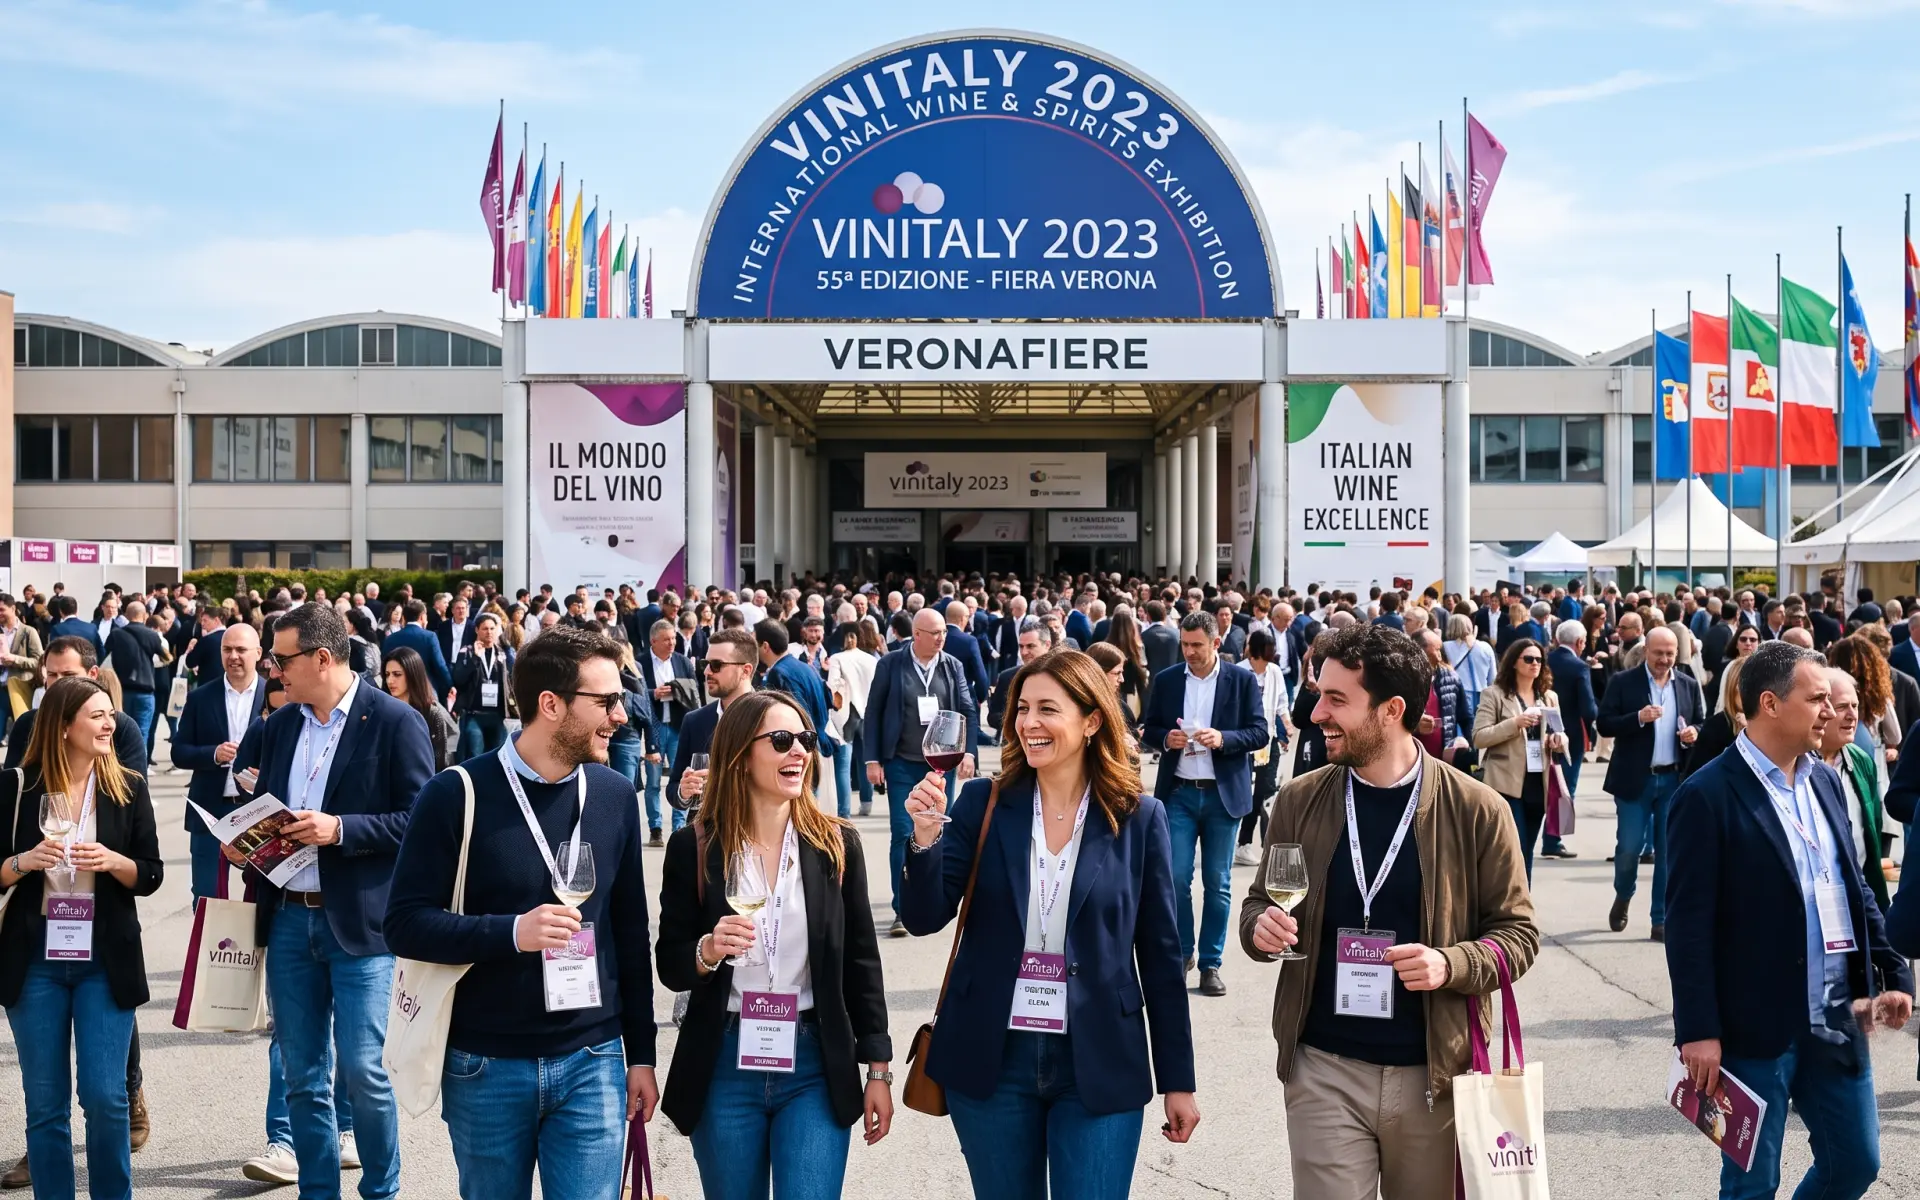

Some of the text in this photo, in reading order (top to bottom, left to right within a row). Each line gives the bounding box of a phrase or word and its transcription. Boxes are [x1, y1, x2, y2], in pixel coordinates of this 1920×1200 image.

[770, 48, 1179, 162] VINITALY 2023
[733, 91, 1239, 303] INTERNATIONAL WINE & SPIRITS EXHIBITION
[812, 218, 1159, 259] VINITALY 2023
[816, 270, 854, 290] 55ª
[861, 270, 970, 290] EDIZIONE
[992, 270, 1056, 290] FIERA
[1060, 270, 1158, 290] VERONA
[823, 338, 1149, 370] VERONAFIERE
[549, 442, 667, 469] IL MONDO
[1320, 442, 1412, 469] ITALIAN
[554, 475, 662, 501] DEL VINO
[889, 472, 1009, 495] vinitaly 2023
[1334, 475, 1399, 501] WINE
[1304, 508, 1430, 530] EXCELLENCE
[209, 949, 261, 971] vinitaly
[1344, 947, 1387, 962] vinitaly
[1021, 963, 1064, 978] vinitaly
[749, 1002, 791, 1018] vinitaly
[1028, 998, 1050, 1006] ELENA
